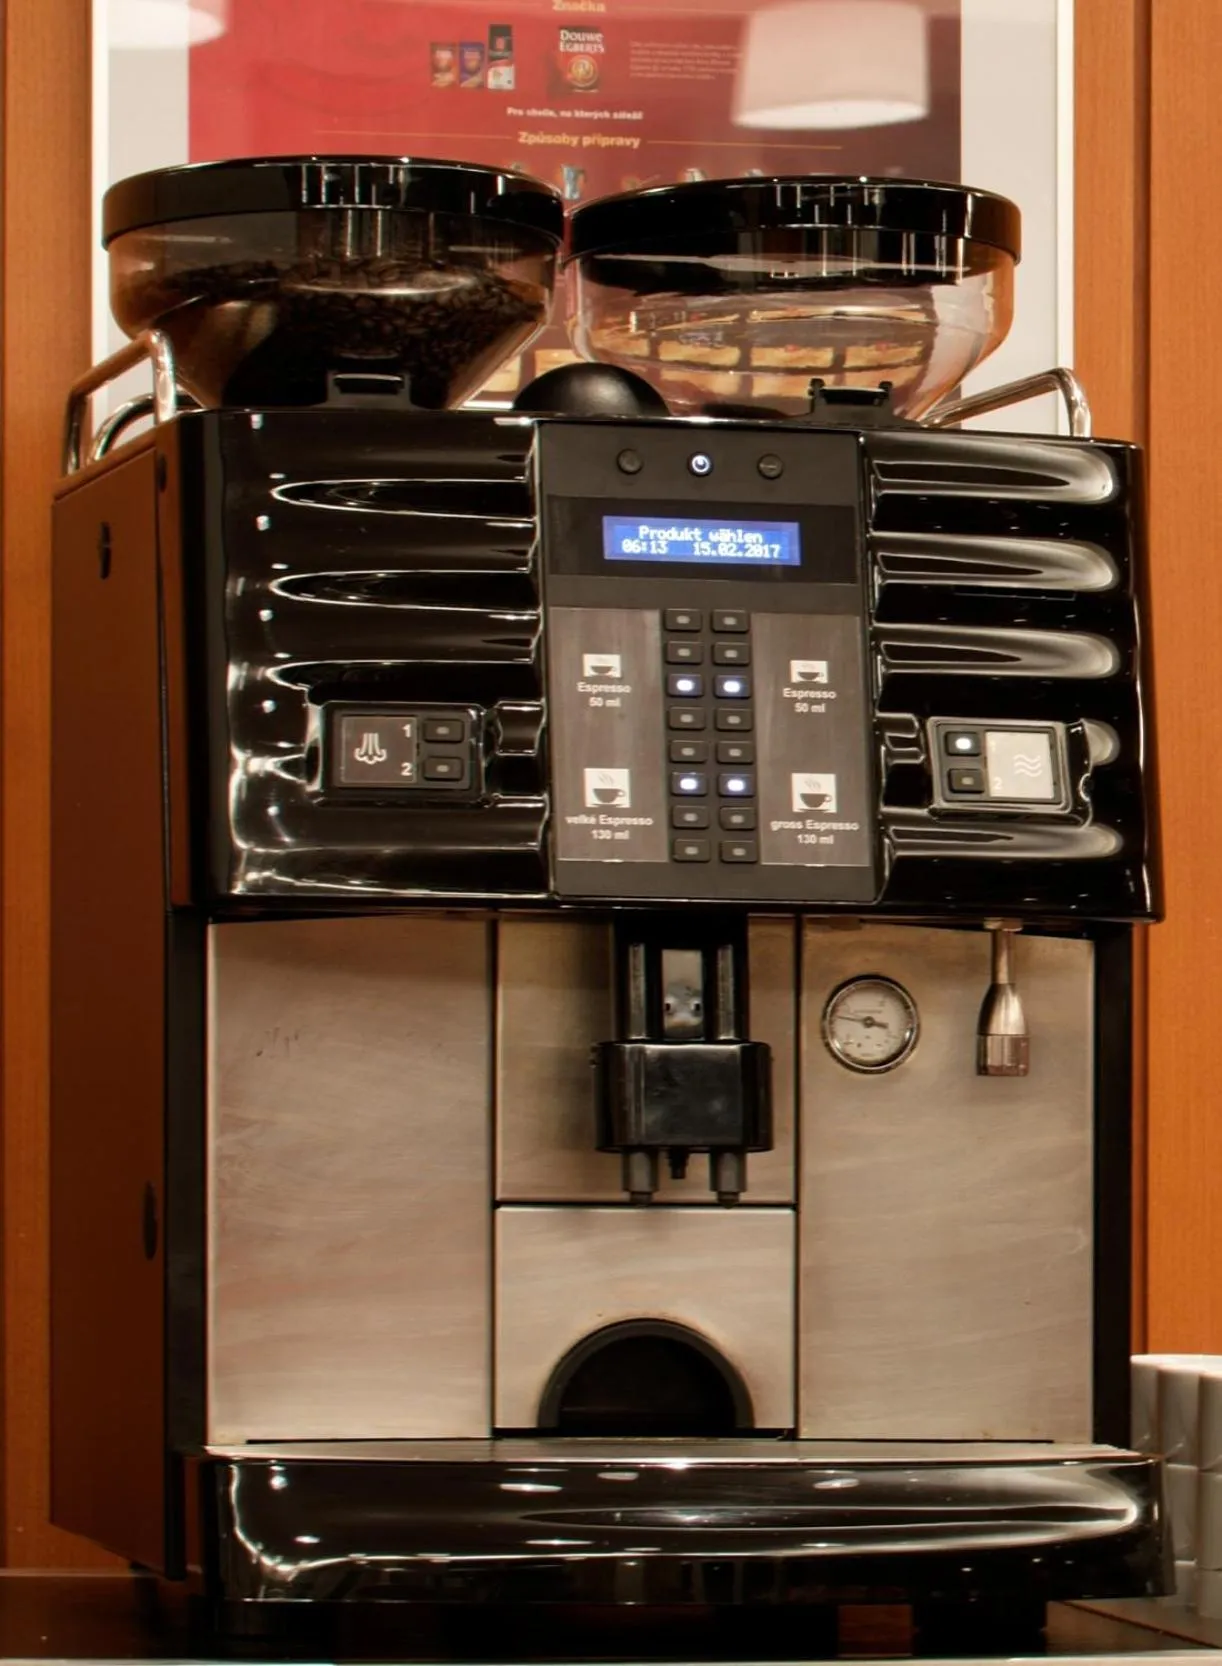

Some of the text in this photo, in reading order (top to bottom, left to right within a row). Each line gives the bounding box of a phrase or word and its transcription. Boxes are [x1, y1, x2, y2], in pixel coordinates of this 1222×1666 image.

[507, 107, 523, 116] Pro
[518, 131, 641, 148] Způsoby přípravy
[639, 525, 763, 543] Produkt wählen
[622, 539, 781, 558] 06:13 15.02.2017
[577, 682, 632, 693] Espresso
[783, 688, 837, 699] Espresso
[589, 697, 621, 707] 50 ml
[795, 703, 826, 713] 50 ml
[402, 724, 411, 738] 1
[401, 762, 413, 776] 2
[565, 815, 653, 826] velké Espresso
[770, 819, 860, 831] gross Espresso
[591, 830, 630, 840] 130 ml
[797, 834, 834, 844] 130 ml
